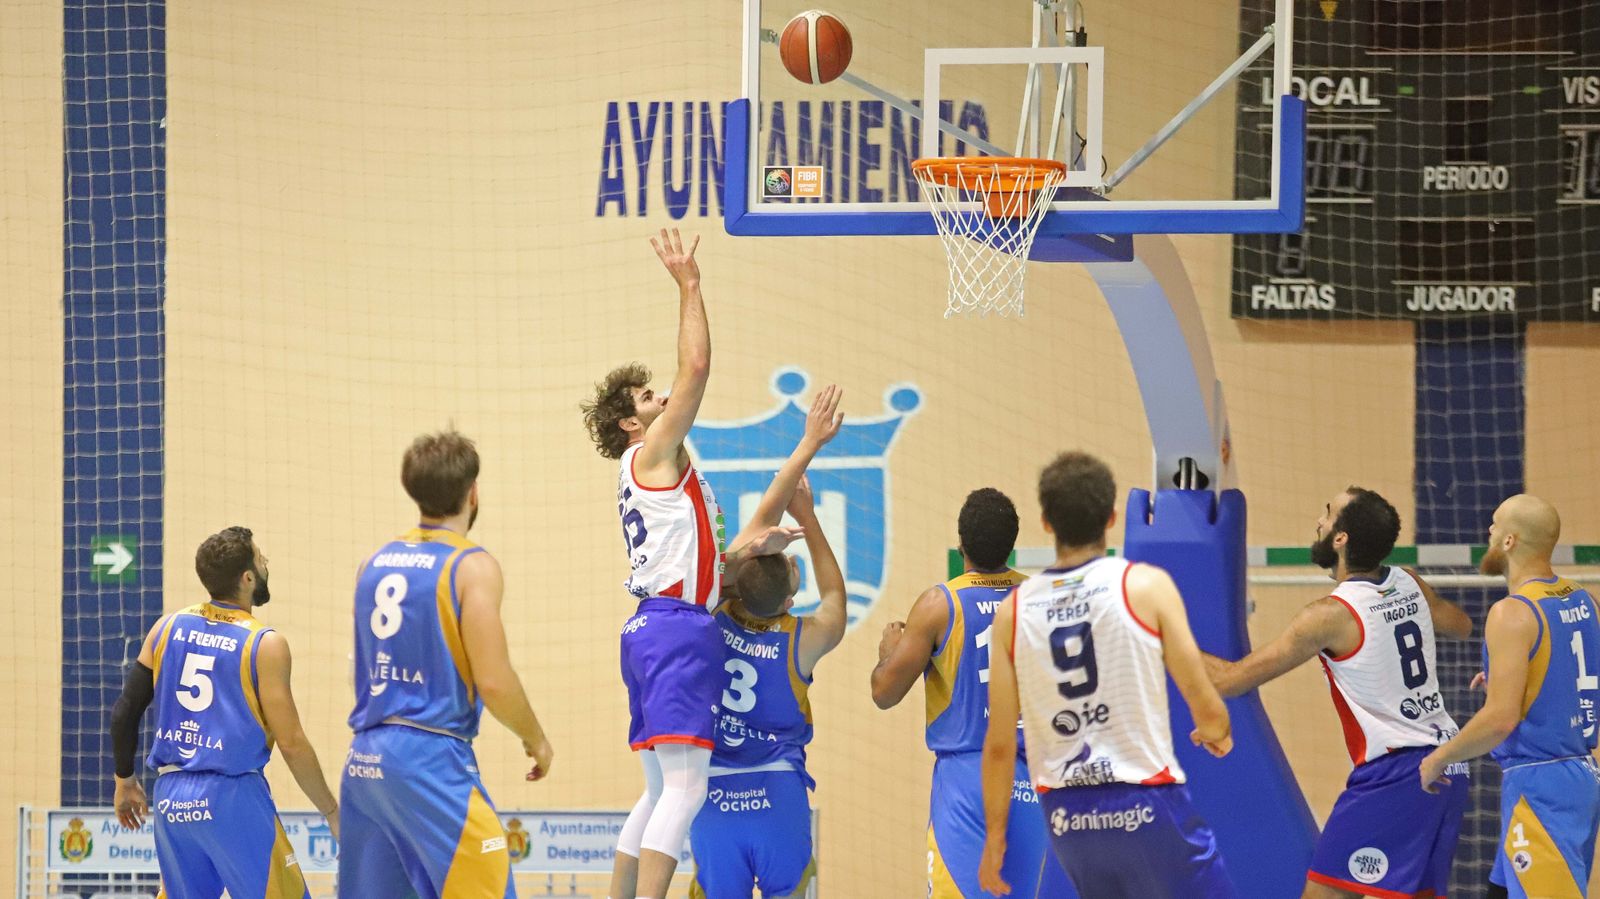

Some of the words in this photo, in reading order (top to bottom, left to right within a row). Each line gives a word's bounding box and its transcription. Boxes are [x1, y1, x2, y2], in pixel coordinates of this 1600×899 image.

[1262, 76, 1381, 106] LOCAL
[798, 171, 818, 181] FIBA
[1423, 165, 1509, 191] PERIODO
[1251, 285, 1336, 310] FALTAS
[1406, 286, 1516, 312] JUGADOR
[370, 573, 408, 640] 8
[1046, 602, 1091, 622] PEREA
[1383, 607, 1405, 624] IAGO
[1407, 603, 1418, 616] ED
[173, 628, 185, 641] A.
[188, 630, 238, 652] FUENTES
[720, 627, 780, 660] EDELJKOVIĆ
[1049, 621, 1098, 700] 9
[1394, 620, 1428, 690] 8
[176, 652, 216, 713] 5
[722, 658, 758, 713] 3
[349, 766, 384, 780] OCHOA
[1073, 761, 1112, 779] EVER
[172, 798, 209, 811] Hospital
[720, 799, 771, 812] OCHOA
[726, 788, 766, 800] Hospital
[1011, 789, 1039, 803] HOA
[167, 810, 212, 823] OCHOA
[1071, 804, 1154, 832] animagic
[541, 820, 623, 838] Ayuntamie
[1512, 823, 1529, 848] 1
[547, 846, 617, 864] Delegaci
